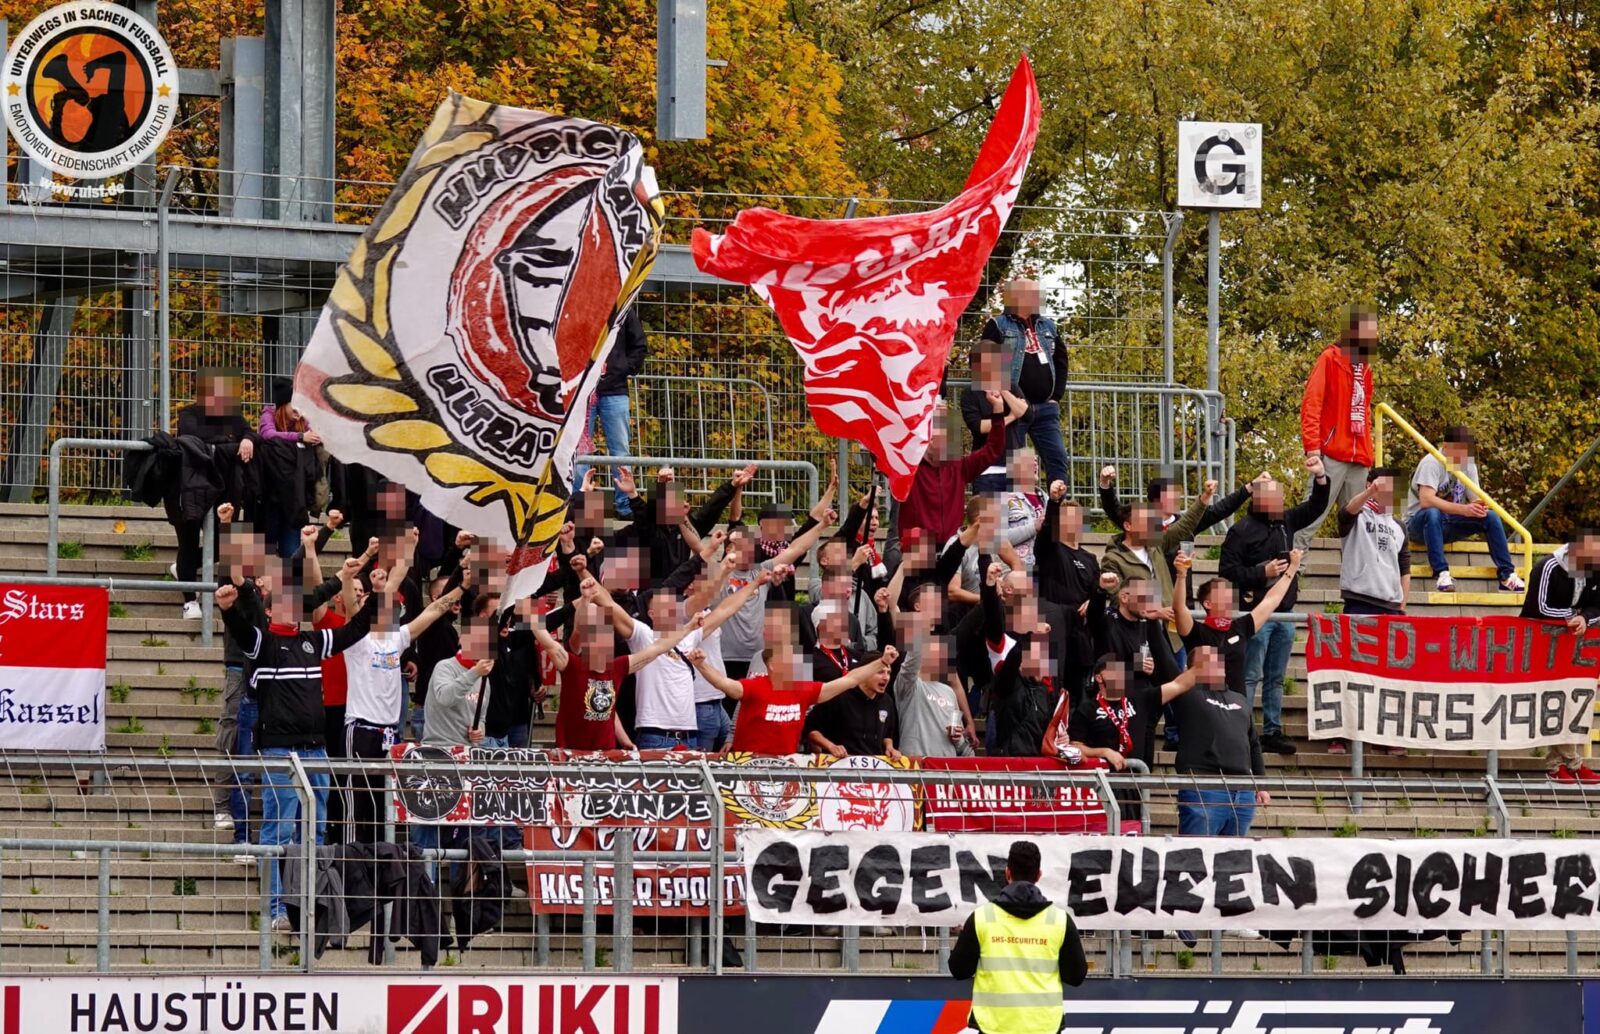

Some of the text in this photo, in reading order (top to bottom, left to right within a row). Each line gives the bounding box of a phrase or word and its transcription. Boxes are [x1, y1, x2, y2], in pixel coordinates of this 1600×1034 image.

[1194, 134, 1246, 196] G
[0, 589, 85, 625] Stars
[1309, 613, 1600, 672] RED-WHITE
[1313, 681, 1595, 741] STARS 1982
[849, 757, 880, 769] KSV
[471, 784, 548, 822] BANDE
[583, 789, 712, 821] BANDE
[539, 873, 653, 907] KASER
[751, 840, 1600, 919] GEGEN EUREN SICHER
[991, 935, 1048, 946] SHS-SECURITY.DE
[70, 982, 339, 1032] HAUSTÜREN
